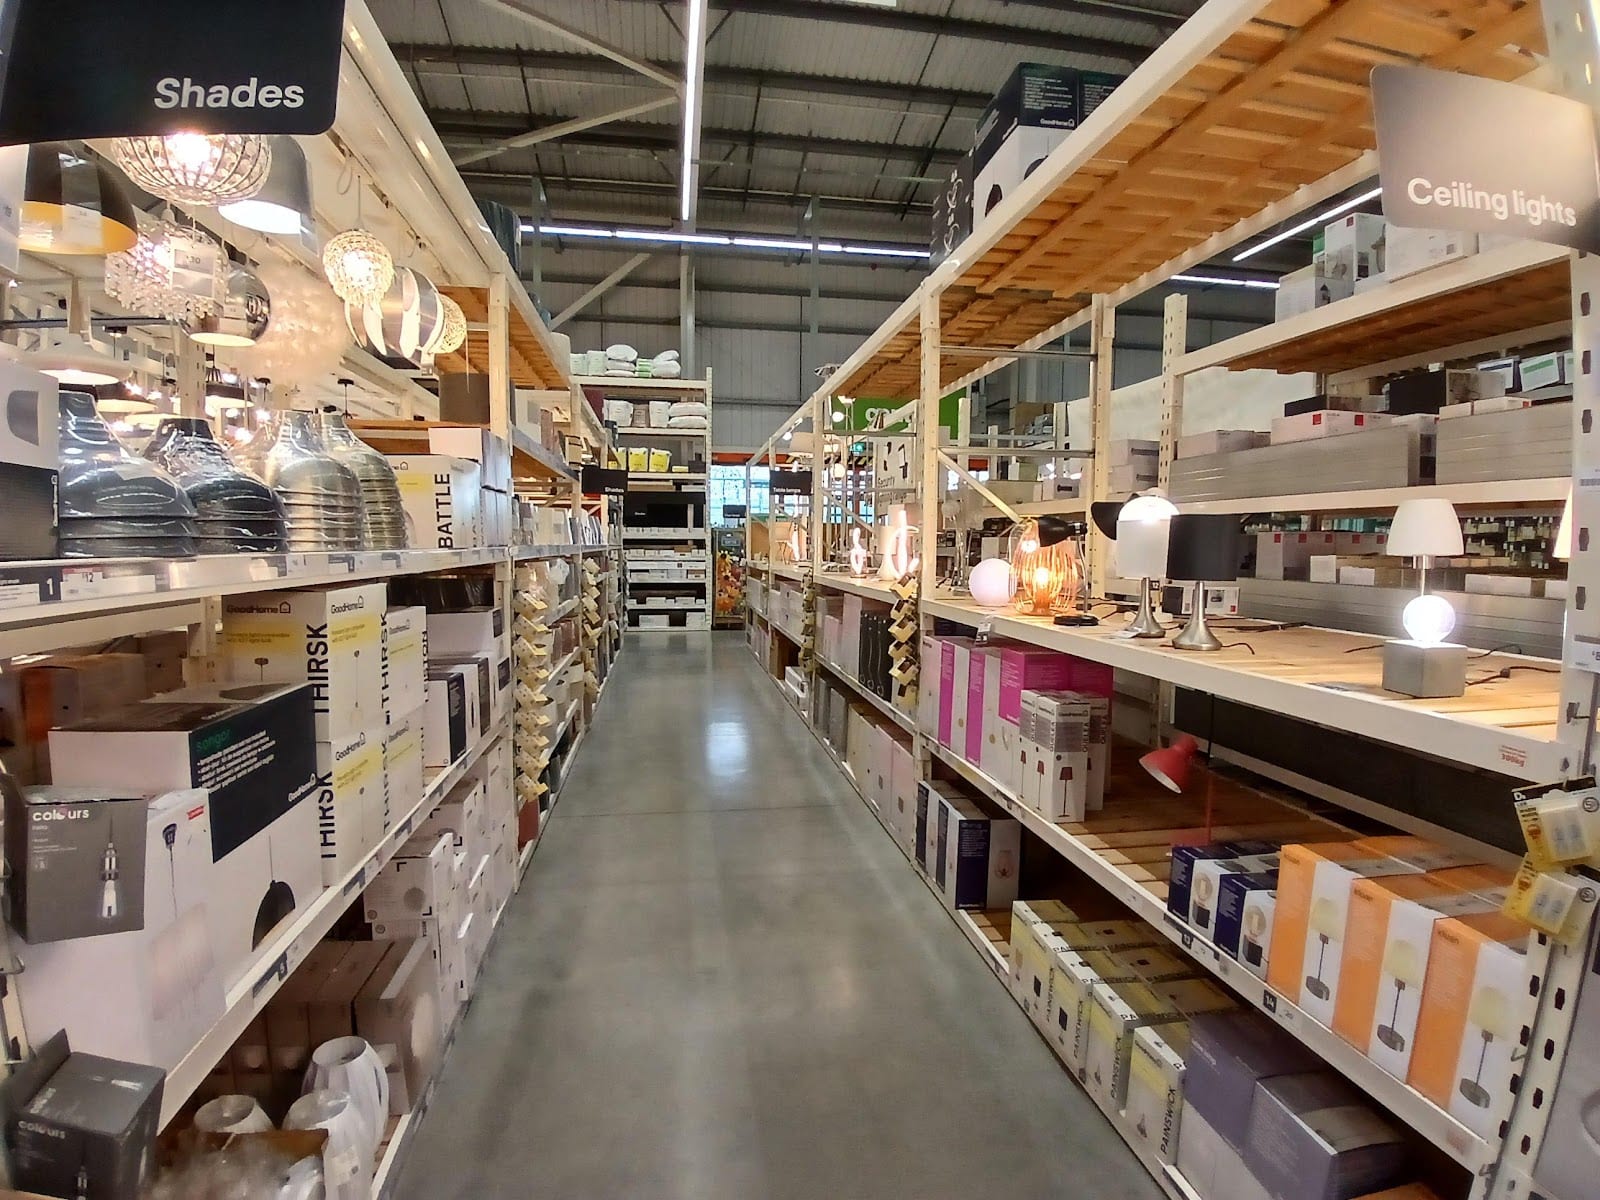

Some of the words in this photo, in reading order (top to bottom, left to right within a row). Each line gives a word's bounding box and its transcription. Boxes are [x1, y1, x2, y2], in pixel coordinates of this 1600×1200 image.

[154, 77, 305, 110] Shades
[1407, 177, 1508, 220] Ceiling
[1513, 189, 1577, 226] lights
[434, 473, 453, 549] BATTLE
[331, 601, 358, 614] GoodHome
[380, 611, 390, 709] THIRSK
[32, 808, 90, 822] colours
[18, 1120, 66, 1140] colours
[1160, 1085, 1176, 1155] PAINSWICK
